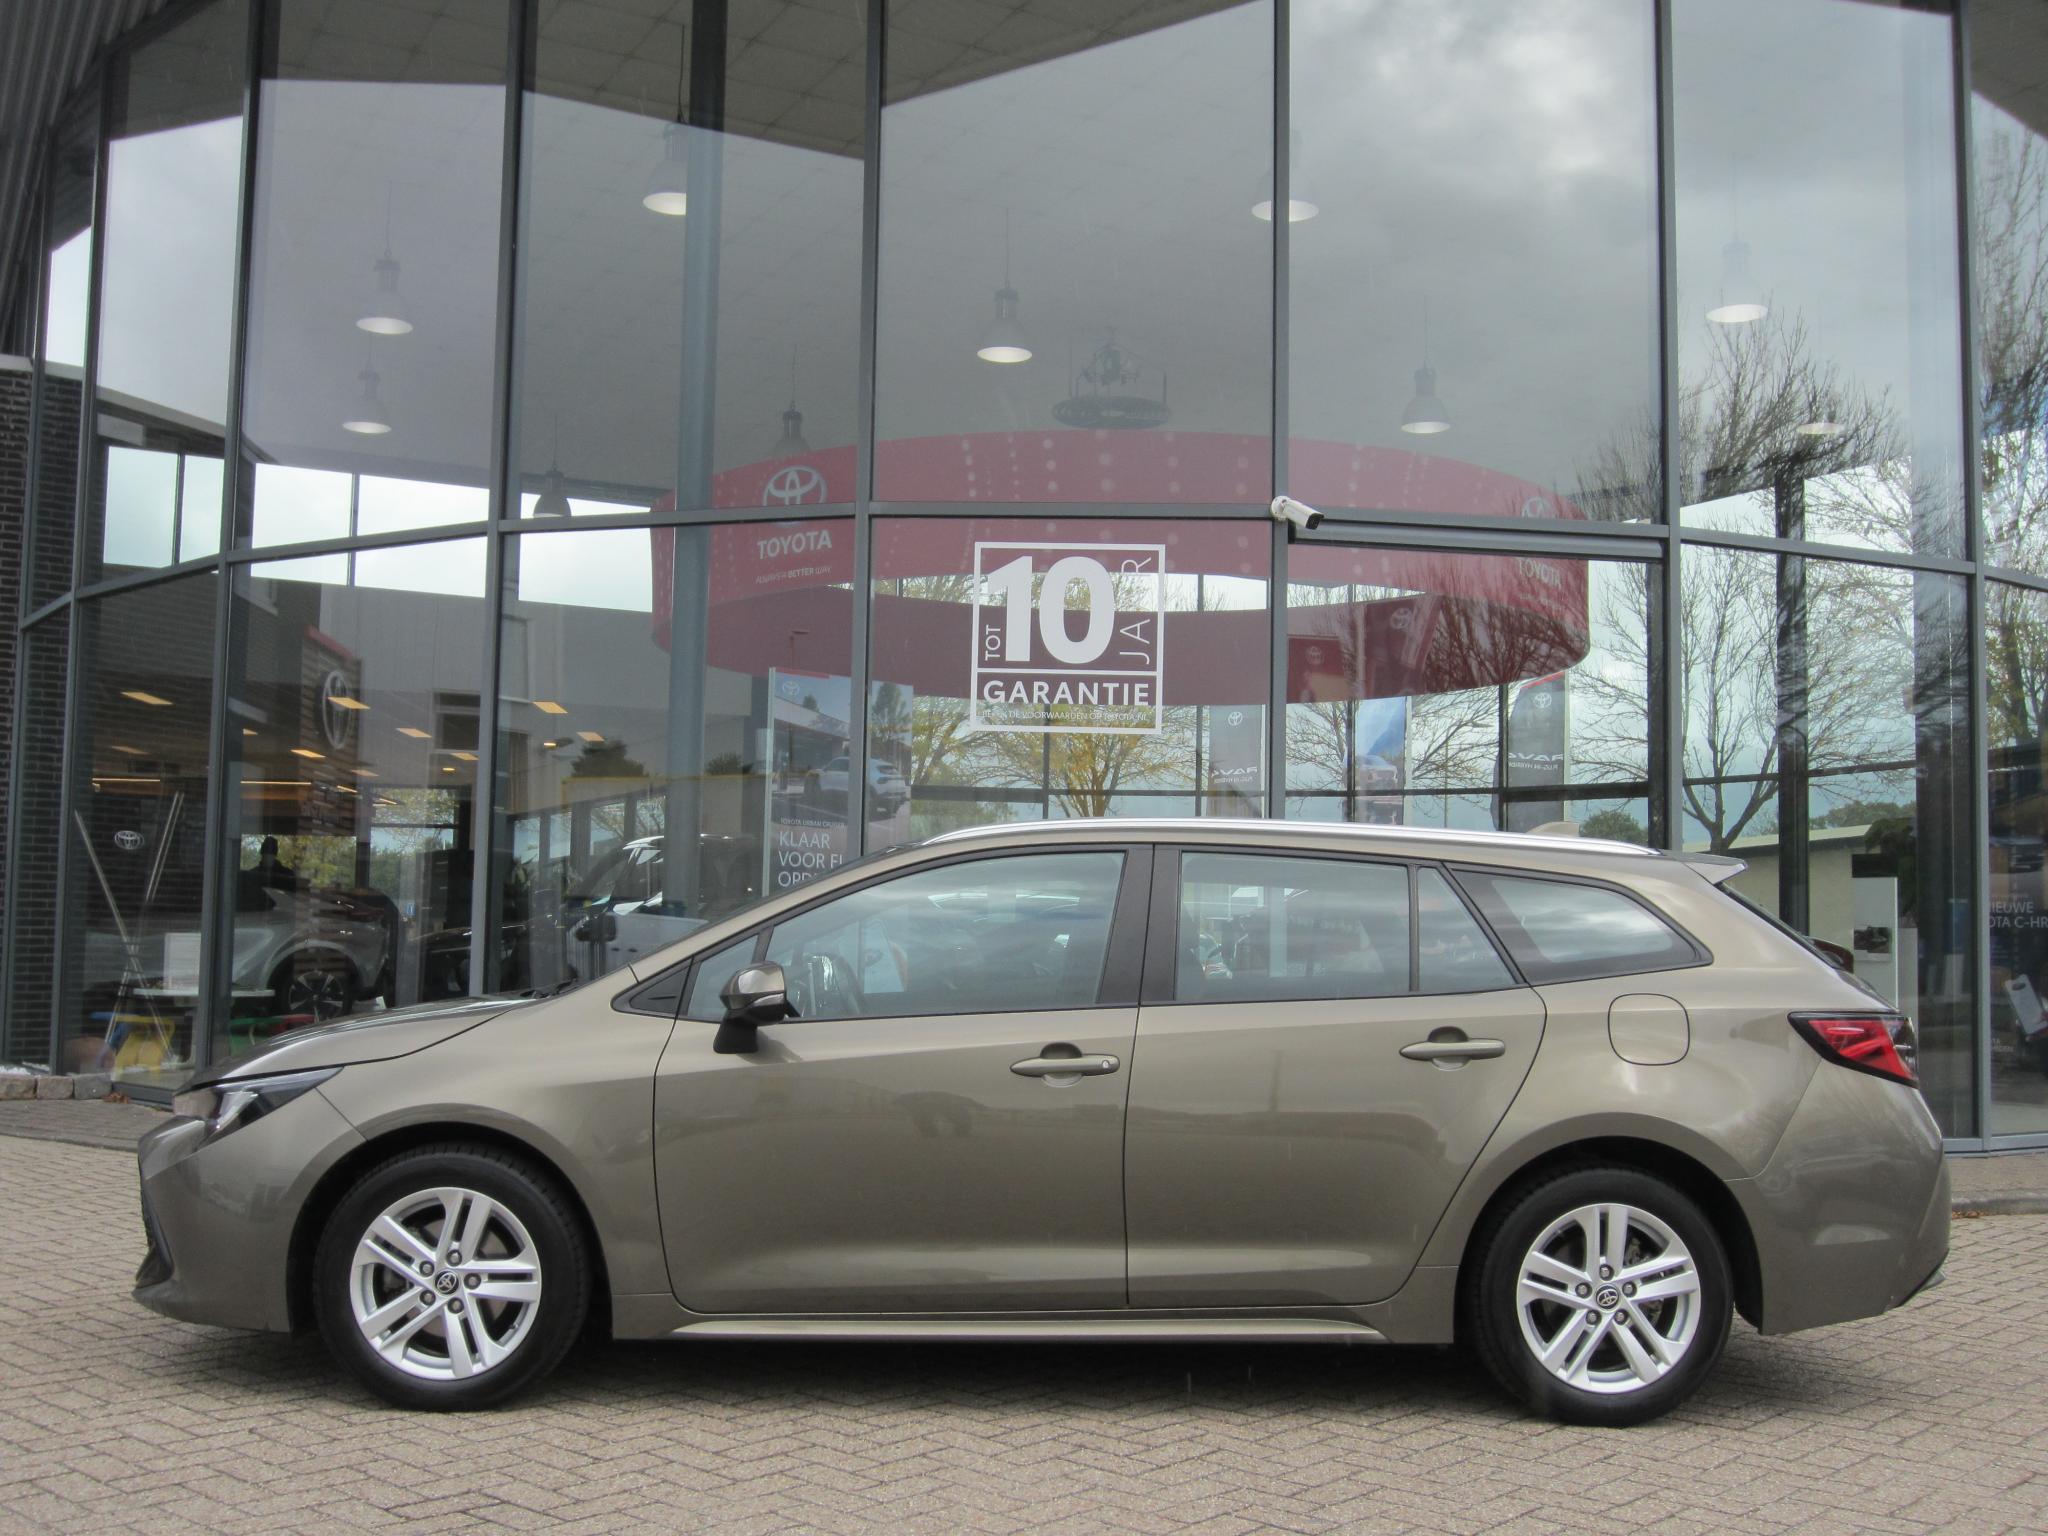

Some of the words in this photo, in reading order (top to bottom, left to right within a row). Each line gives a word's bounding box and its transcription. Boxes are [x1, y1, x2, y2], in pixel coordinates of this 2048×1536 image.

[757, 530, 832, 560] TOYOTA
[987, 555, 1115, 664] 10
[1119, 557, 1152, 665] JAR
[984, 624, 1001, 661] TOT
[983, 680, 1149, 706] GARANTIE
[779, 831, 830, 849] KLAAR
[778, 850, 825, 868] VOOR
[1990, 901, 2034, 914] IEUWE
[2014, 916, 2048, 929] C-HR
